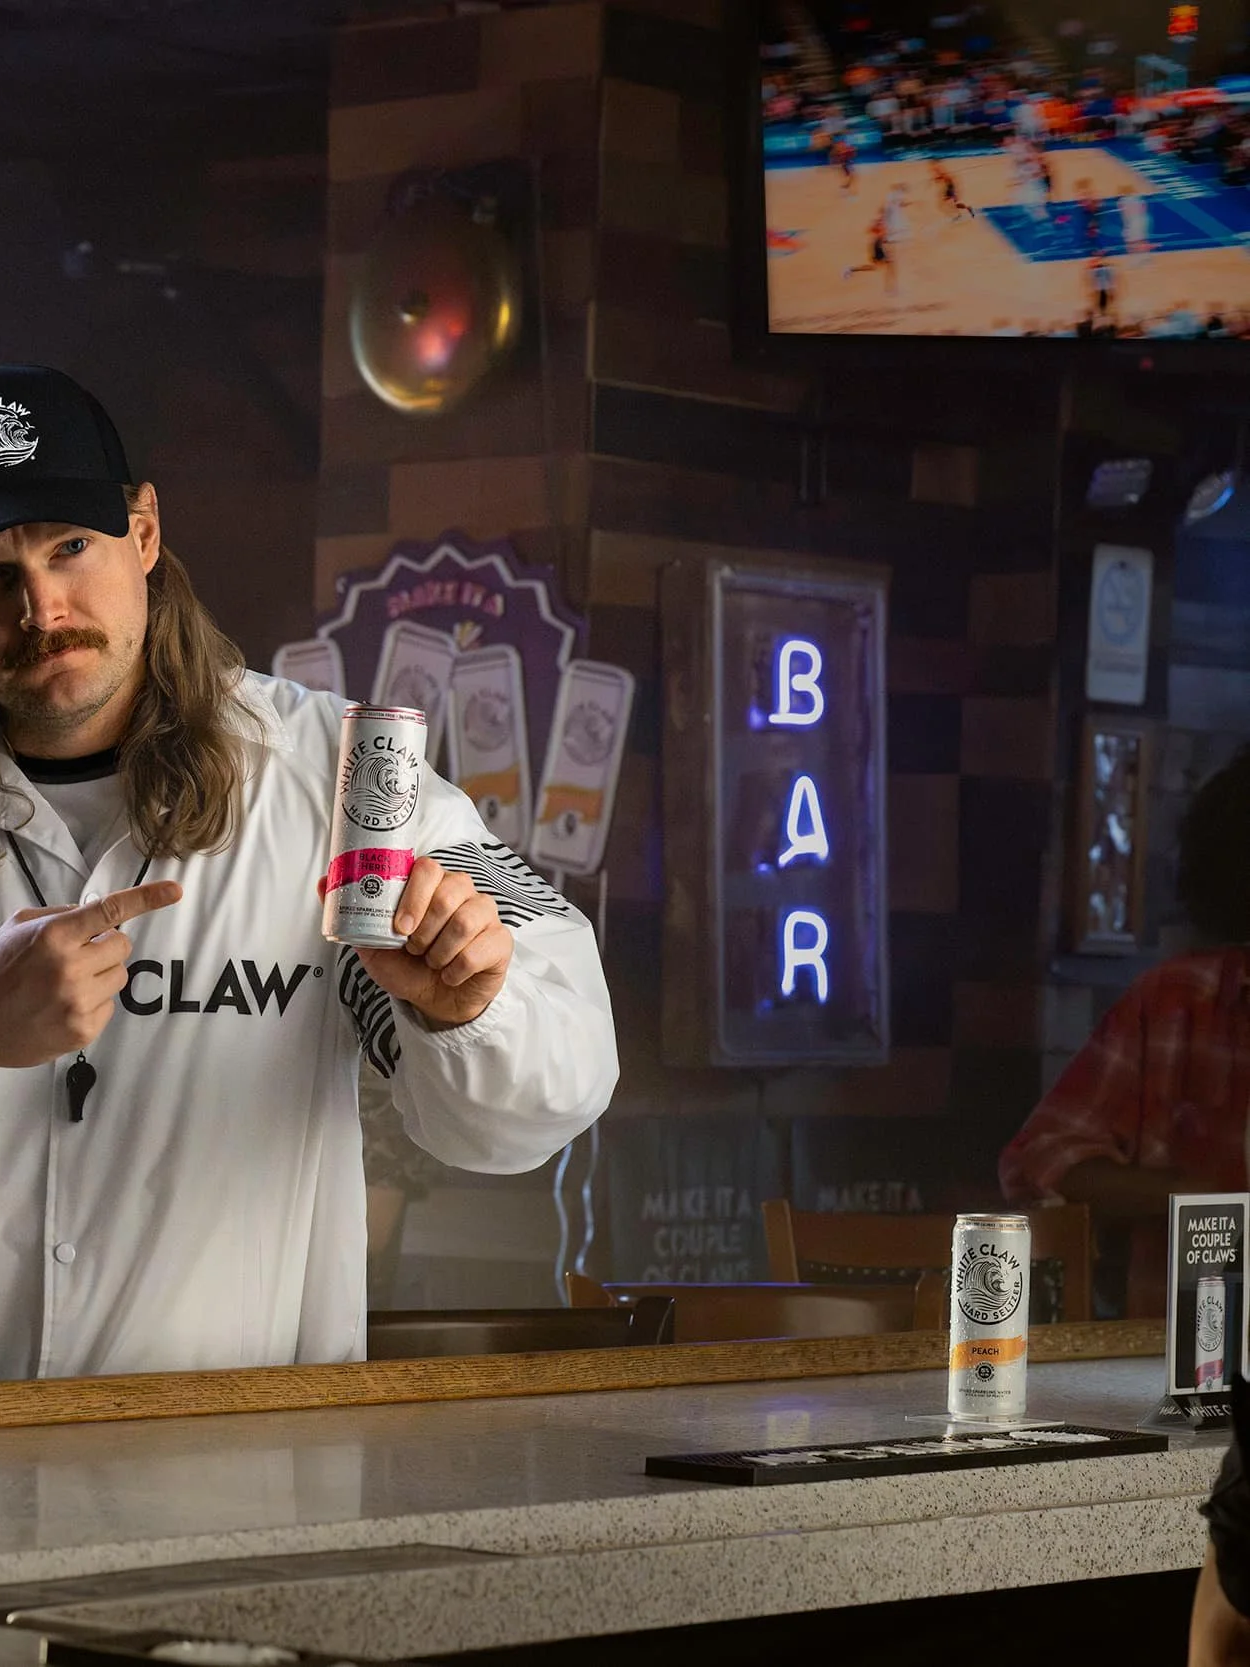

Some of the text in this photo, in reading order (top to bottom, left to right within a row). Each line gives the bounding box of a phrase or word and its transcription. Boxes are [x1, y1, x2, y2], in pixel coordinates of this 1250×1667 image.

[339, 736, 418, 795] WHITE CLAW
[349, 783, 417, 826] HARD SELTZER
[768, 639, 830, 1003] BAR
[1187, 1217, 1236, 1232] MAKE IT A
[1192, 1233, 1231, 1248] COUPLE
[956, 1243, 1020, 1293] WHITE CLAW
[1187, 1250, 1201, 1264] OF
[963, 1281, 1020, 1321] HARD SELTZER
[971, 1346, 1000, 1355] PEACH
